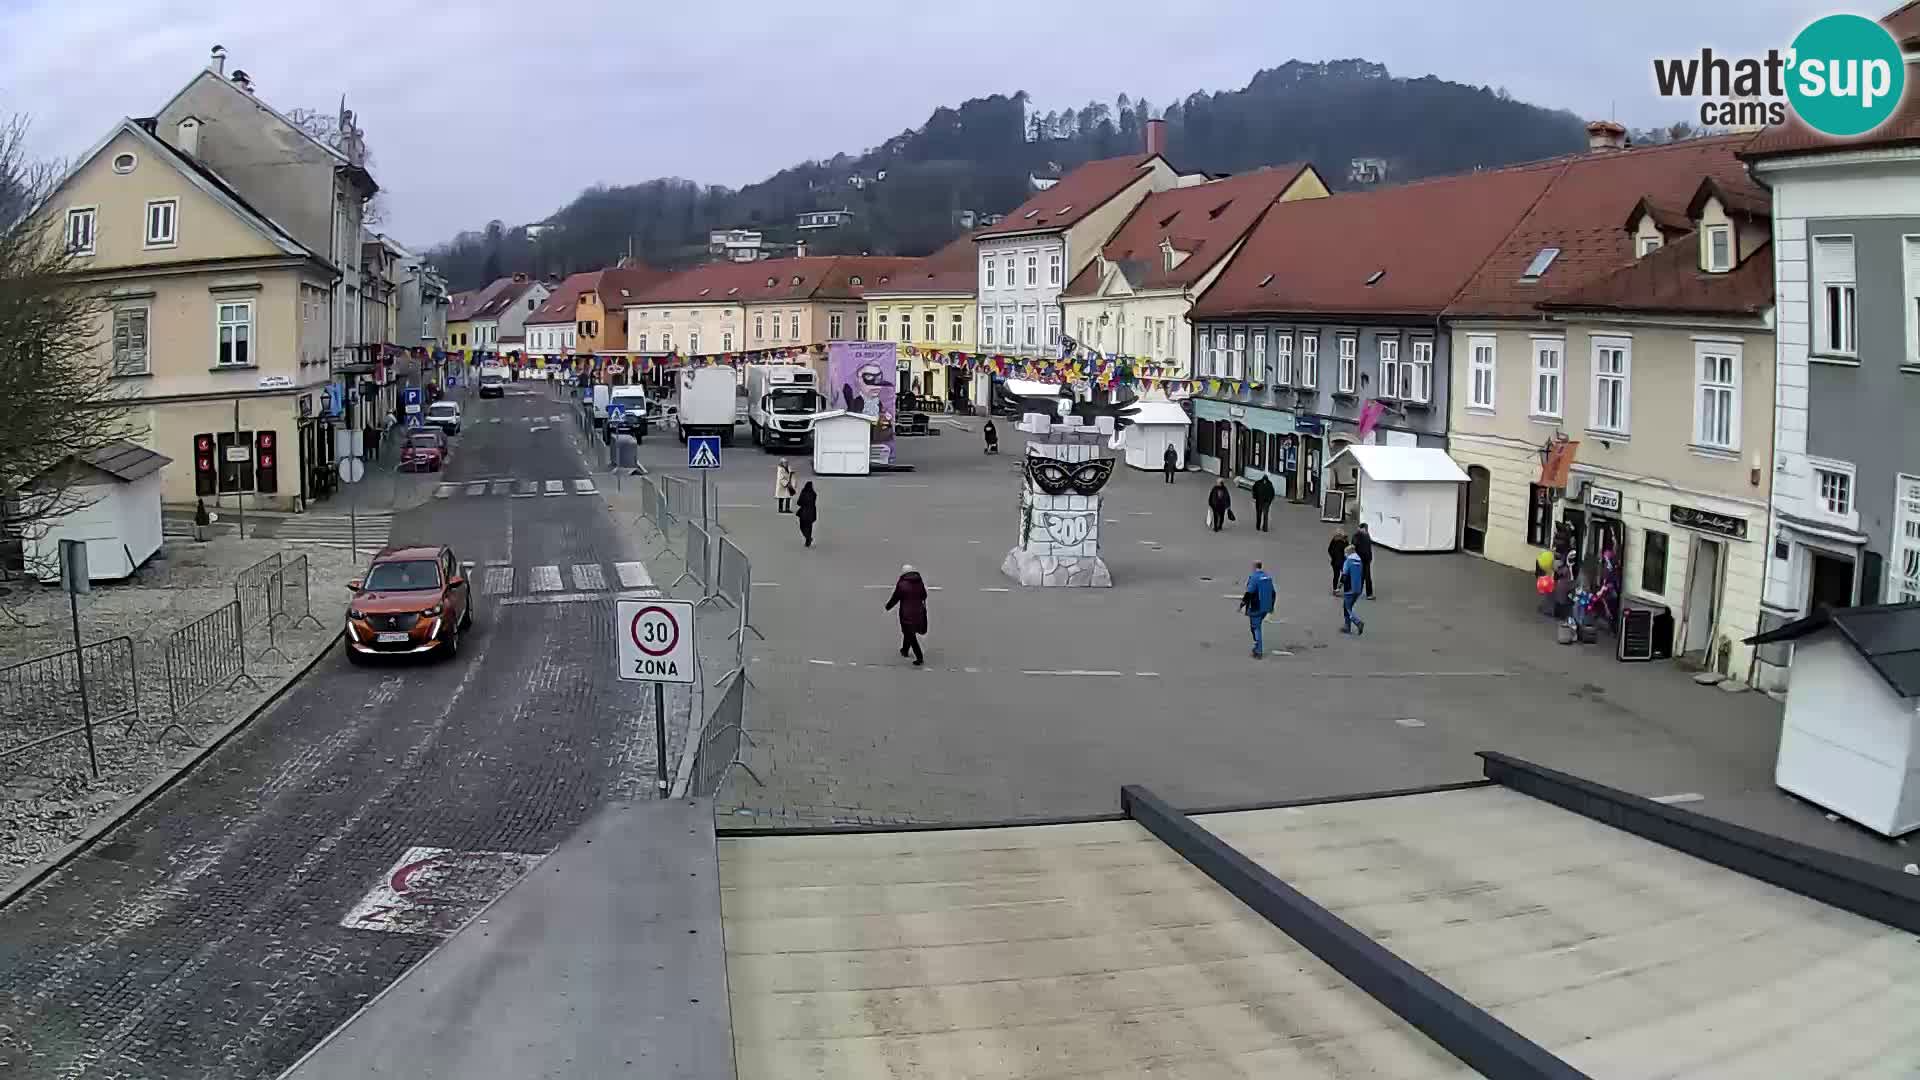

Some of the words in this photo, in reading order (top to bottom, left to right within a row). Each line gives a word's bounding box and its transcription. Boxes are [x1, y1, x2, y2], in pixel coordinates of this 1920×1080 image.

[1047, 515, 1087, 546] 200
[643, 622, 668, 642] 30
[634, 659, 678, 676] ZONA
